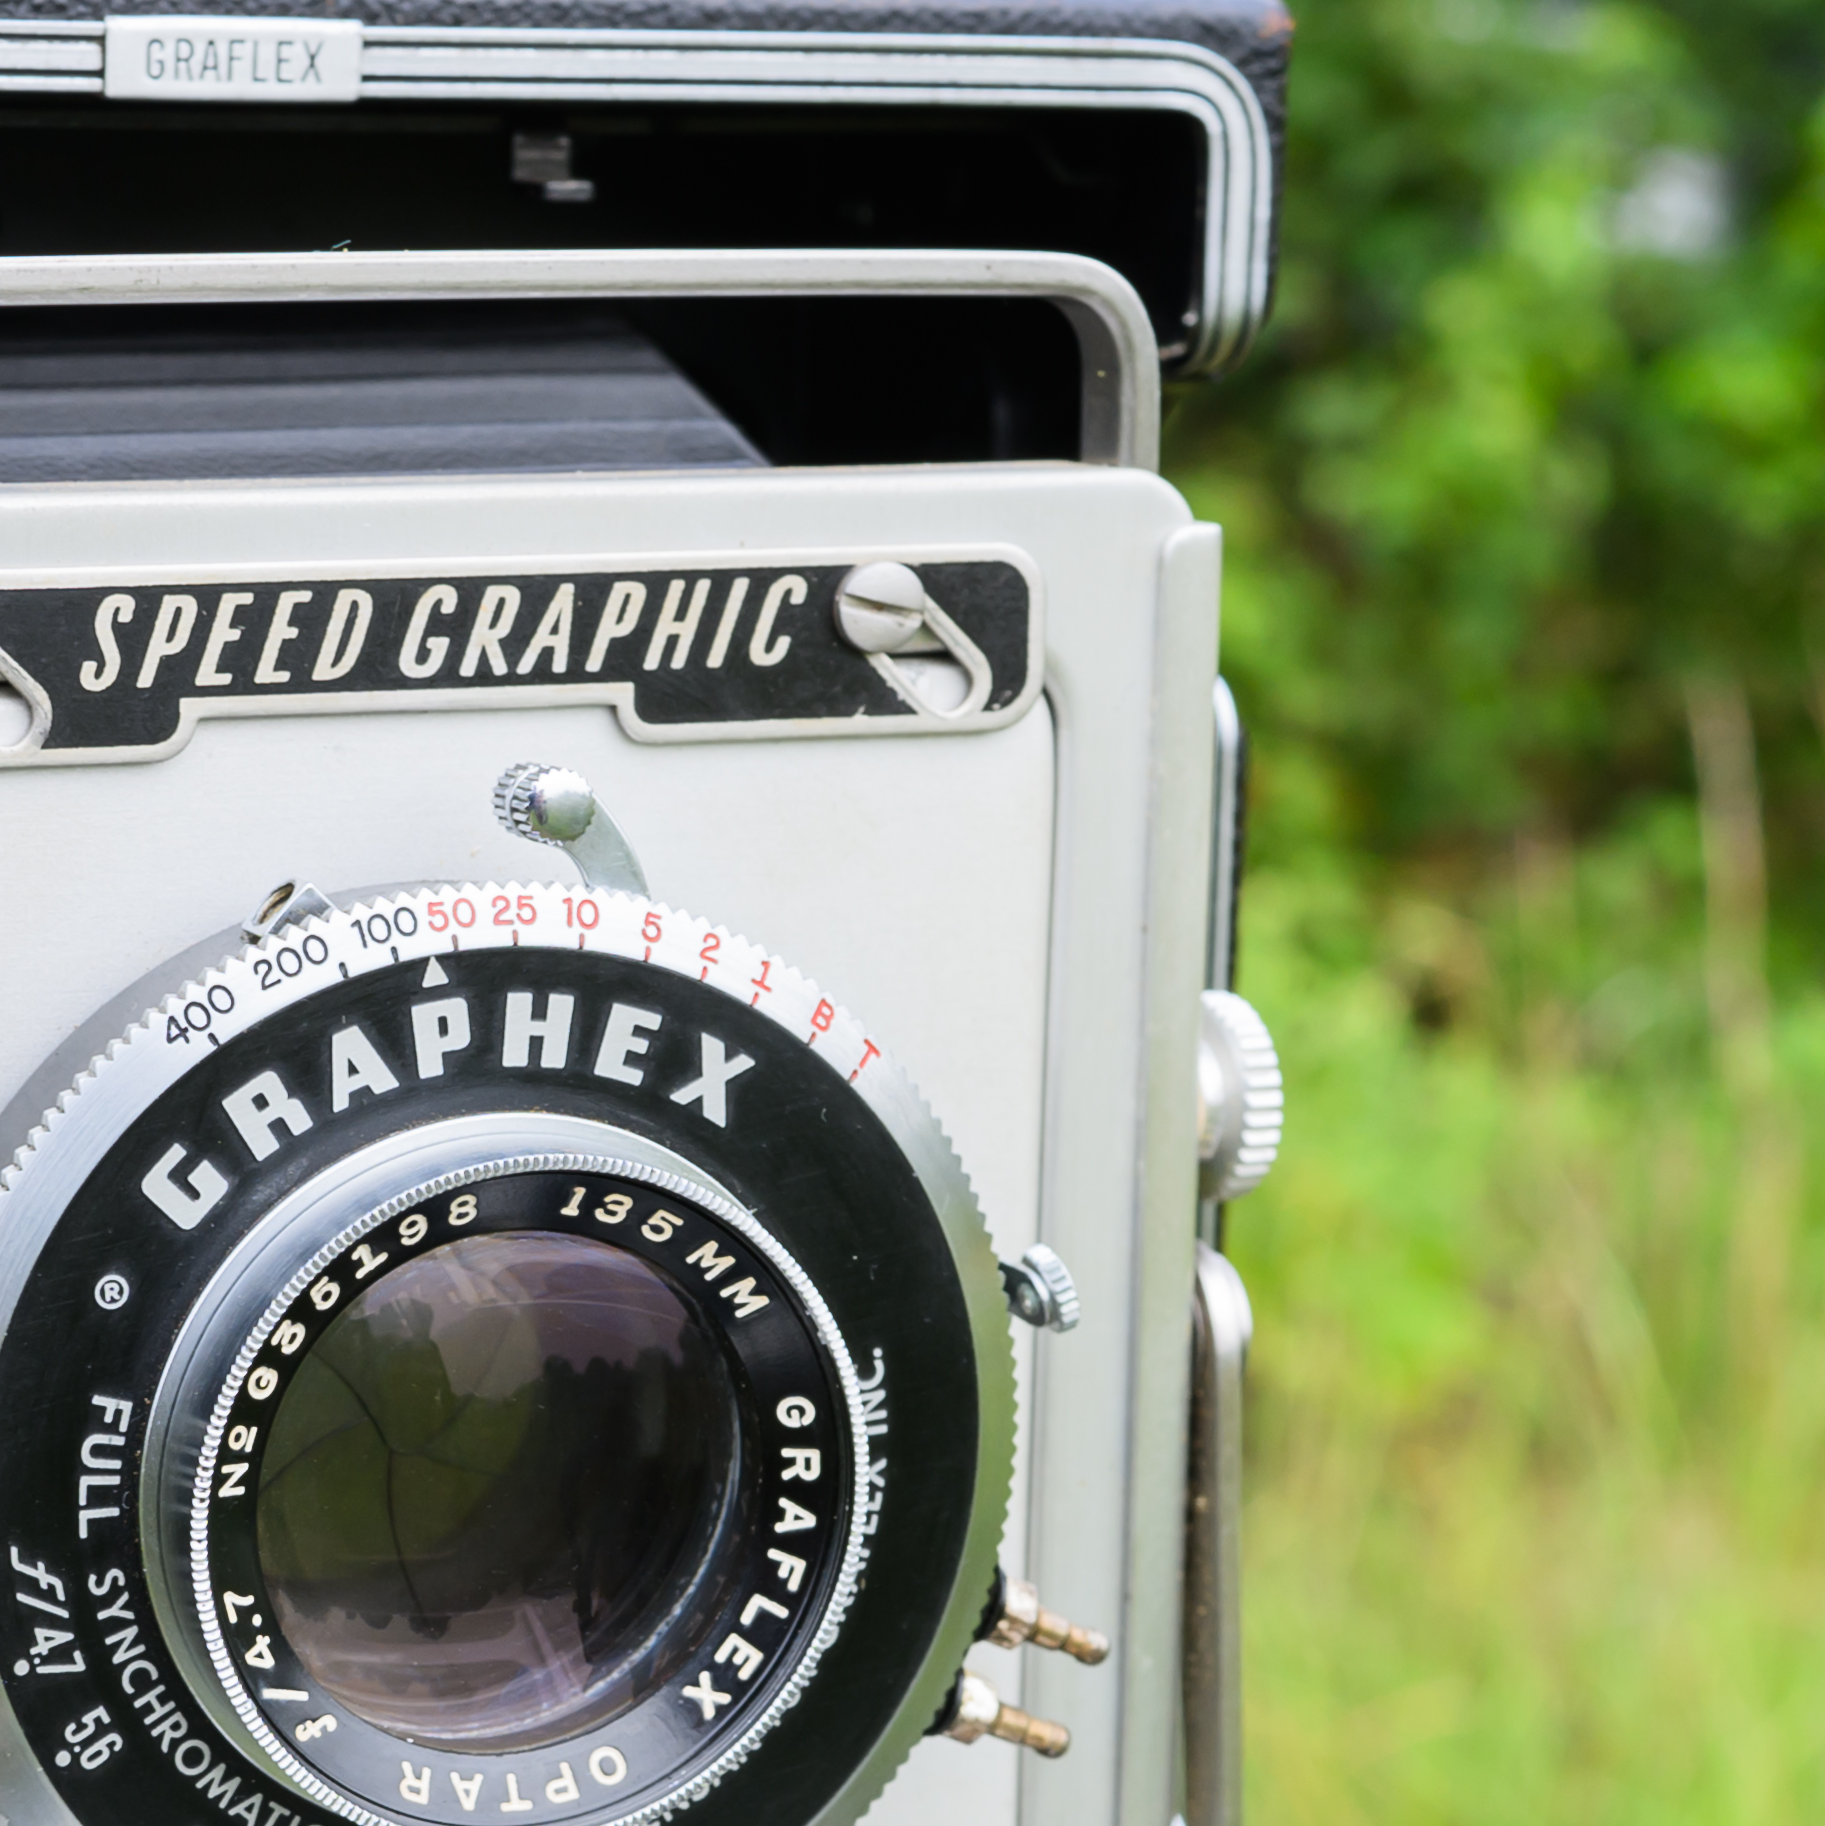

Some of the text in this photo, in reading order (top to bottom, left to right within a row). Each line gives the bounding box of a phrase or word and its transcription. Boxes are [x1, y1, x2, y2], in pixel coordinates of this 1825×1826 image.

[146, 38, 323, 83] GRAFLEX
[79, 573, 809, 692] SPEED GRAPHIC
[165, 894, 881, 1069] 400 200 100 50 25 10 5 2 1 B T
[140, 991, 757, 1231] GRAPHEX
[78, 1394, 134, 1539] FULL
[682, 1395, 822, 1722] GRAFLEX
[399, 1745, 628, 1813] OPTAR
